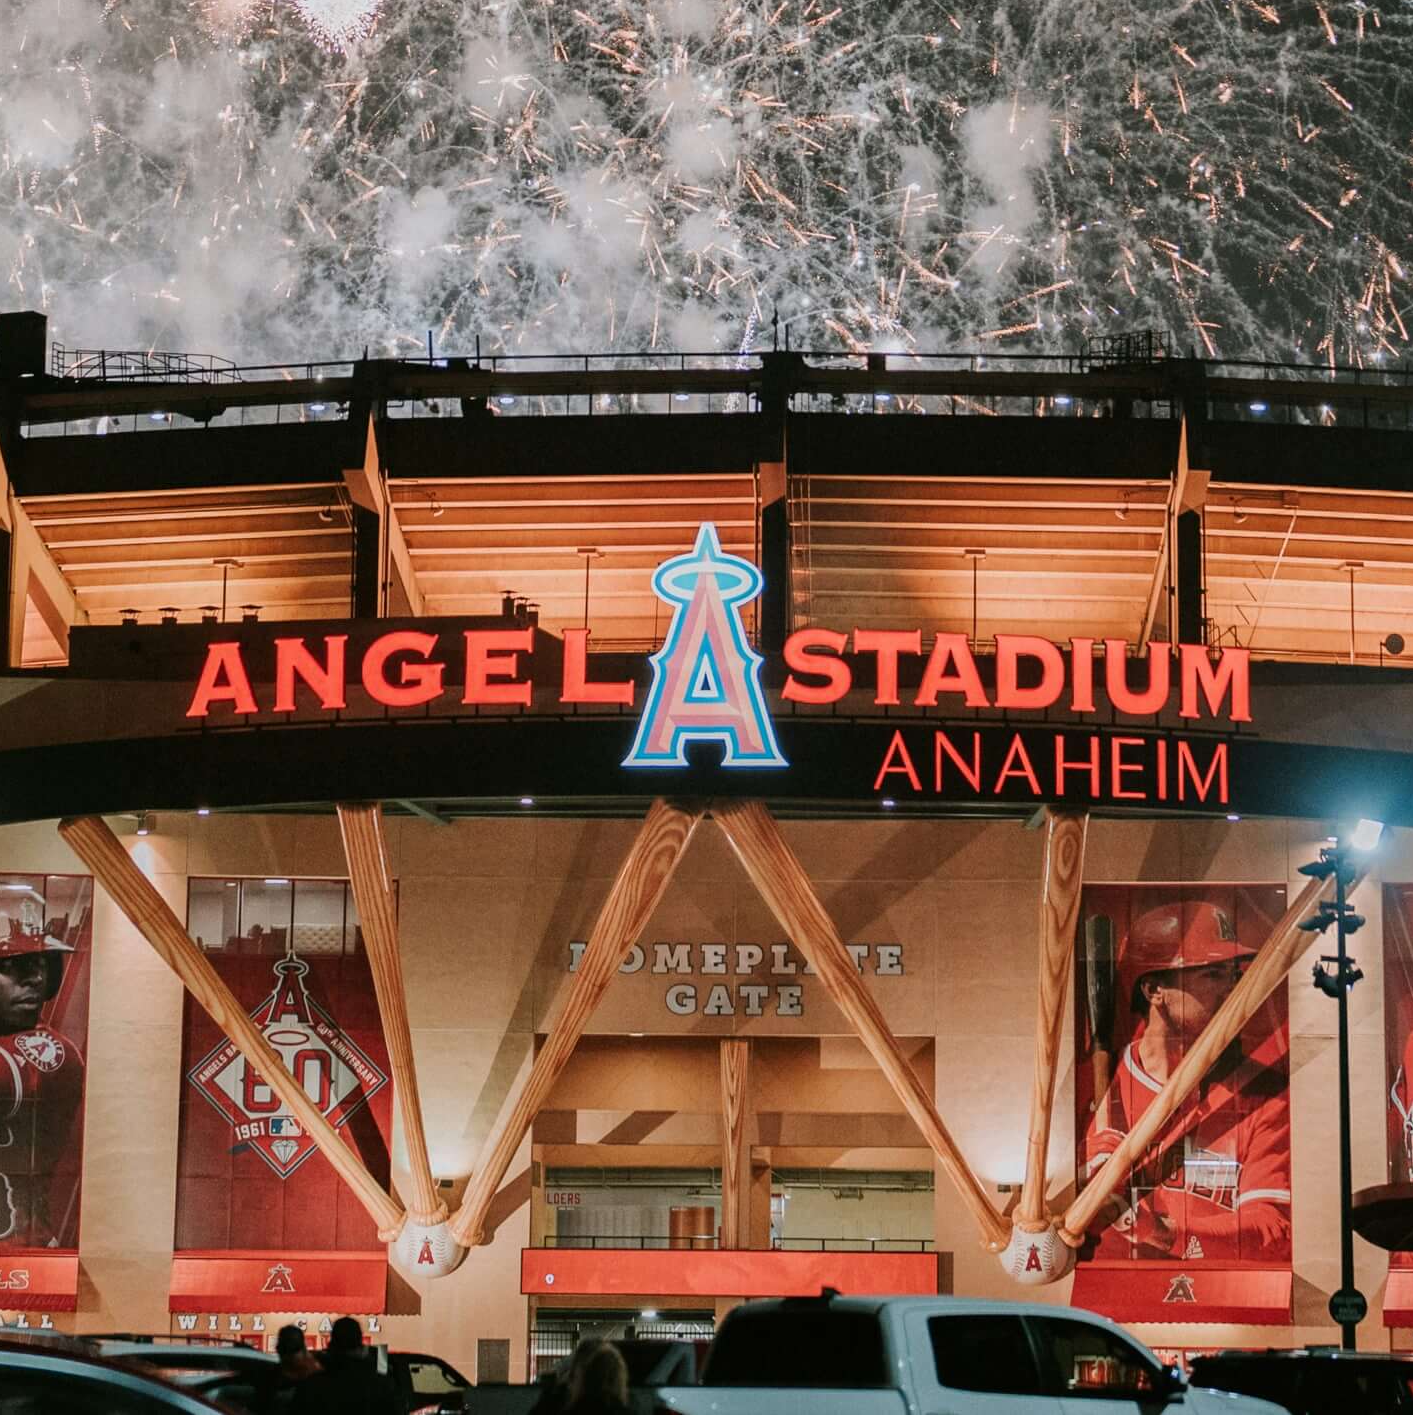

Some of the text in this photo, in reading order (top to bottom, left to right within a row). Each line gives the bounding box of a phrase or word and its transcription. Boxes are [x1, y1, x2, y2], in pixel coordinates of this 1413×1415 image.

[186, 626, 635, 718] ANGEL
[781, 627, 1253, 722] STADIUM
[874, 730, 1230, 804] ANAHEIM
[570, 943, 903, 975] OMEPLTE
[666, 985, 803, 1016] GATE
[235, 1121, 266, 1141] 1961
[178, 1315, 381, 1332] WILL CAL
